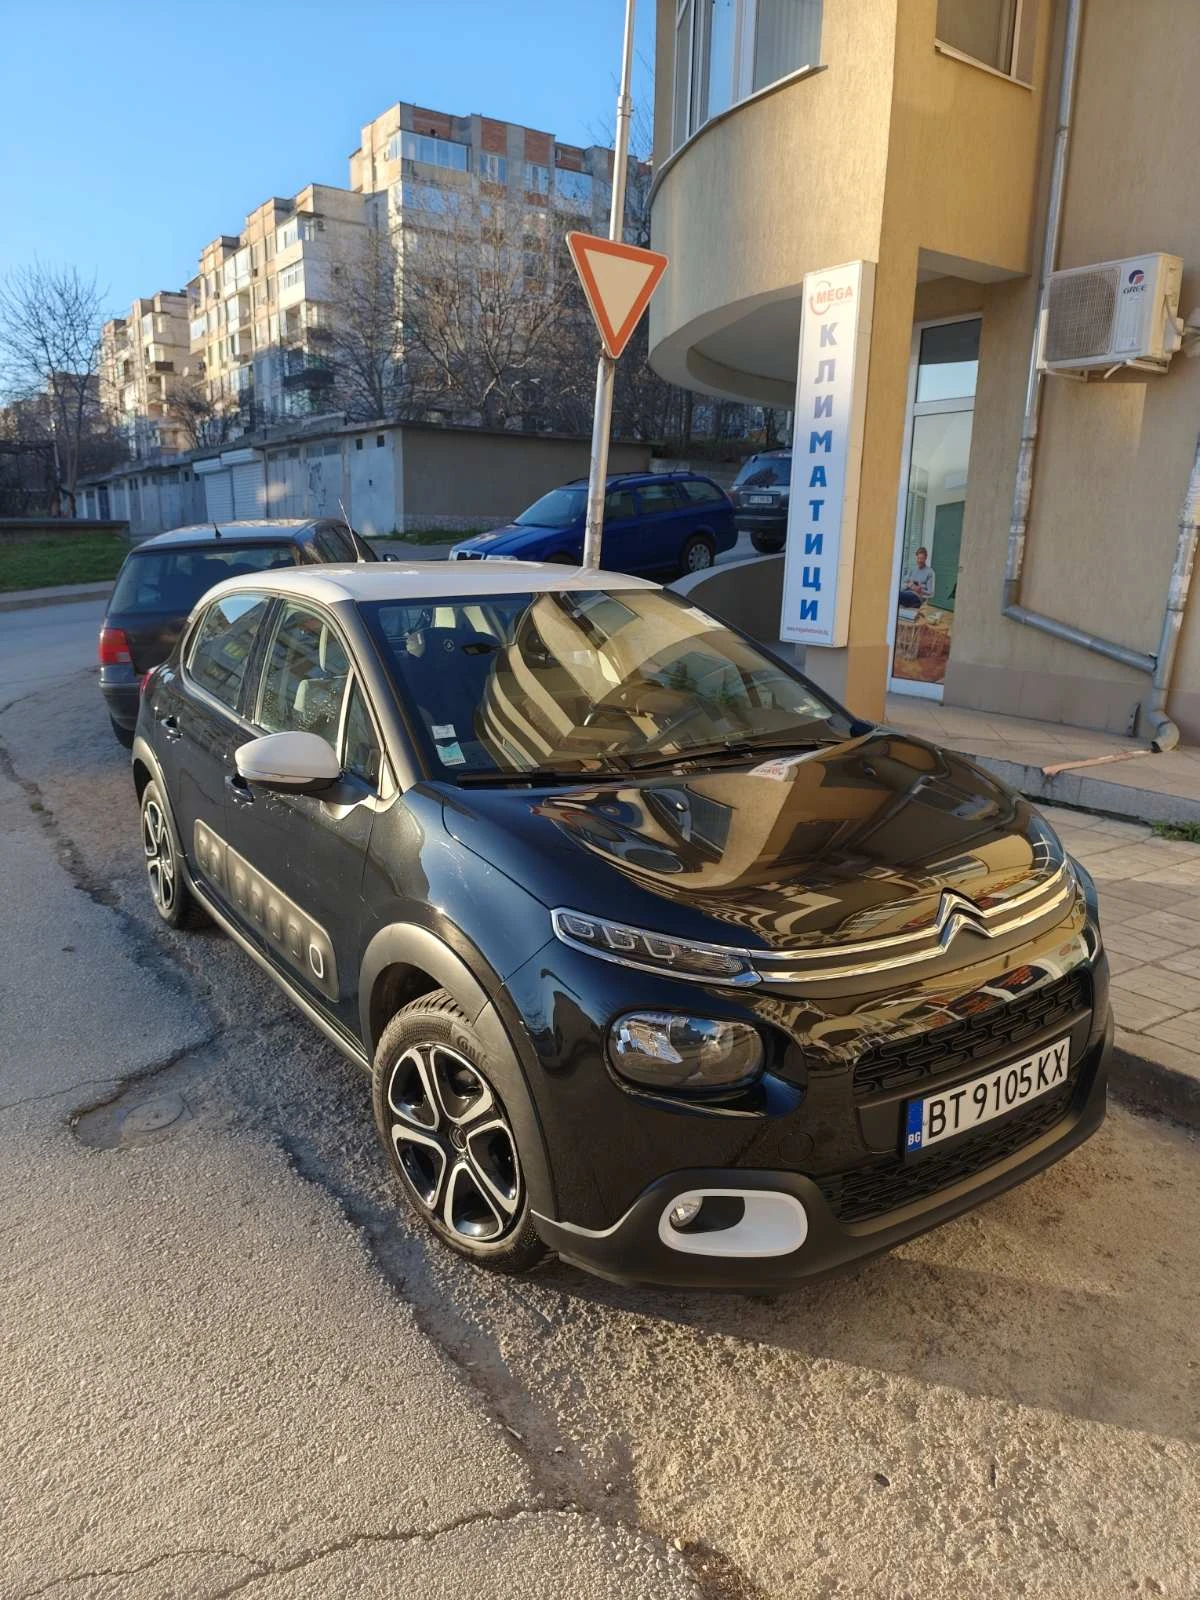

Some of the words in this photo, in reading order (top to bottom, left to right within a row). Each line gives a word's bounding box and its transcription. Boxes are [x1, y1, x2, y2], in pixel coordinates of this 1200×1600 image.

[816, 285, 853, 304] MEGA
[799, 322, 839, 621] КЛИМАТИЦИ
[928, 1089, 967, 1139] BT
[973, 1061, 1033, 1120] 9105
[1037, 1044, 1065, 1090] KX
[907, 1131, 921, 1145] BG
